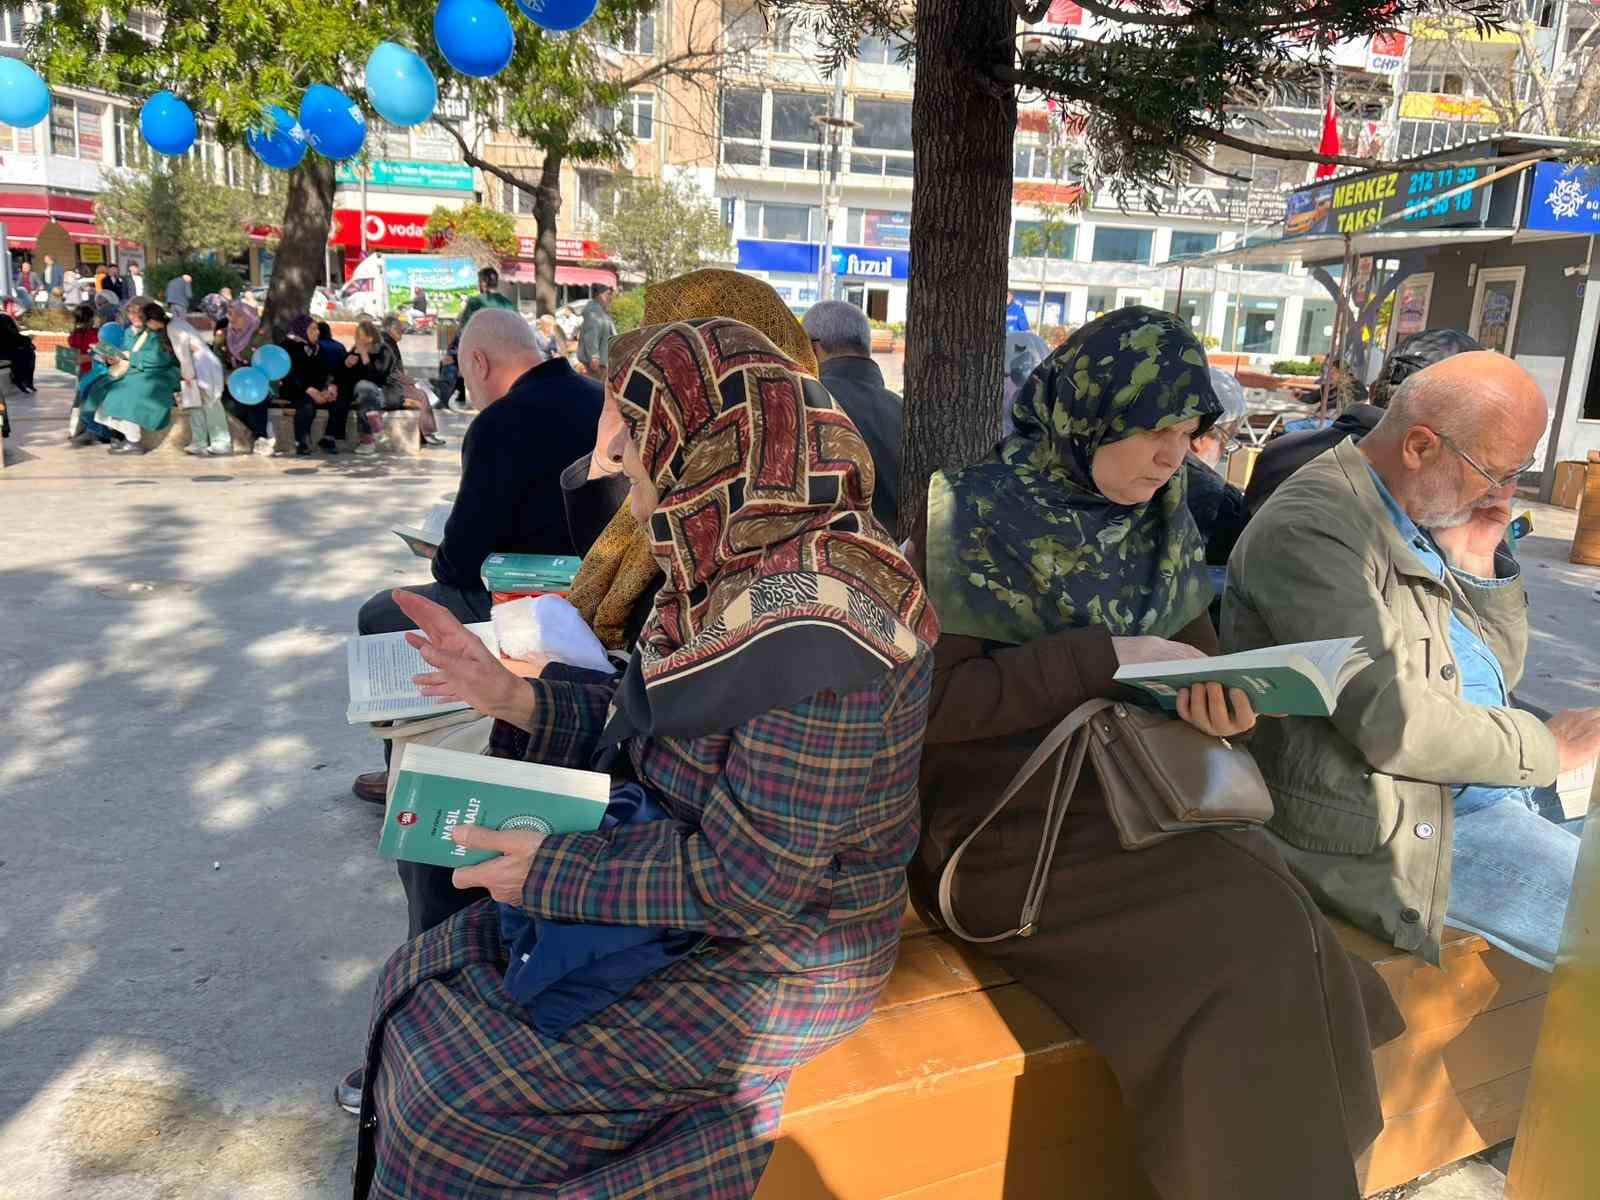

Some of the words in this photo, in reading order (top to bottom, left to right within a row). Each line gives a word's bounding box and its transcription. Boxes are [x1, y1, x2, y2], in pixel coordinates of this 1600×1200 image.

[1372, 57, 1400, 71] CHP
[1333, 173, 1400, 207] MERKEZ
[1337, 201, 1384, 233] TAKSİ
[846, 253, 893, 277] fuzul
[440, 808, 461, 841] NASIL
